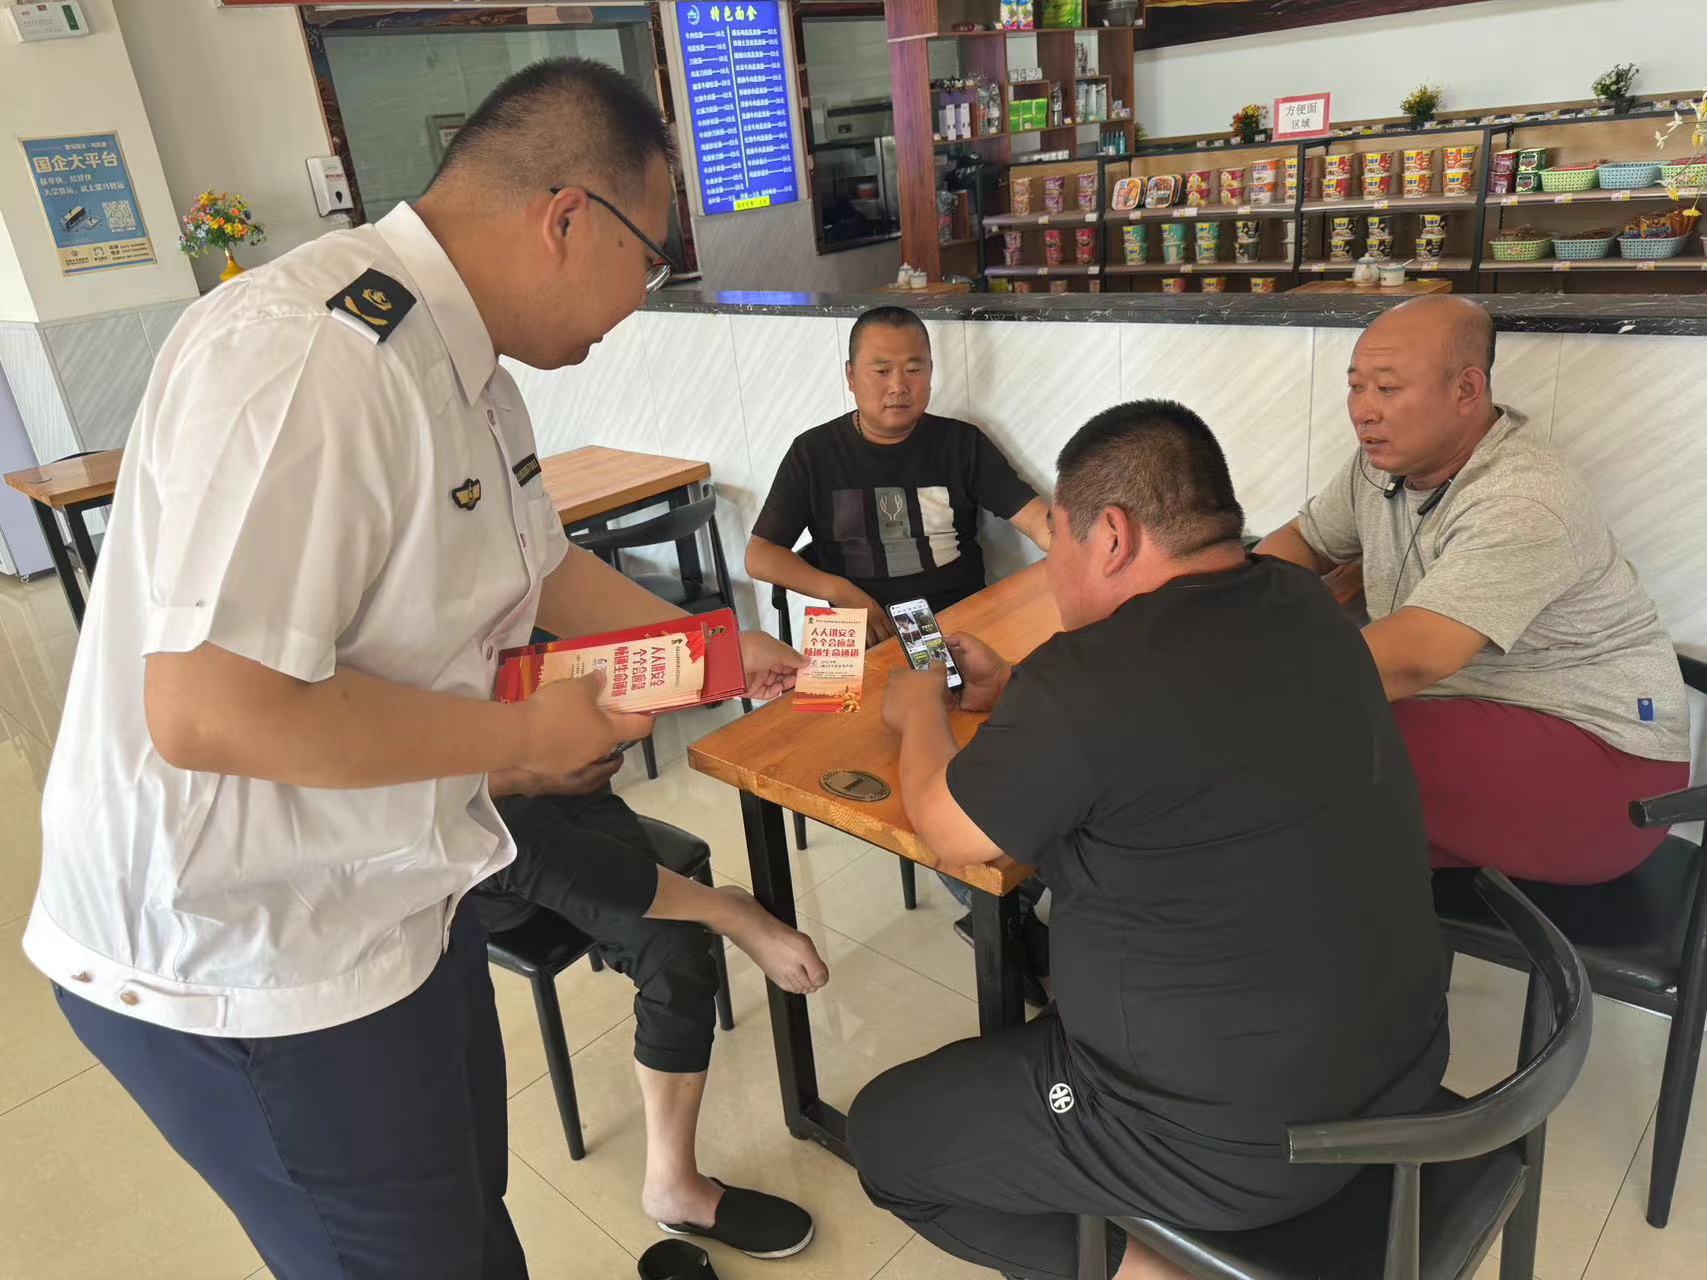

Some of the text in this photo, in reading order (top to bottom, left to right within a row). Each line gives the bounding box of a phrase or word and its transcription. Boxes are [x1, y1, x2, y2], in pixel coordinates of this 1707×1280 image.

[1285, 102, 1318, 116] 方便面
[1291, 118, 1311, 129] 区域
[32, 152, 118, 173] 国企大平台
[811, 628, 856, 637] 人人讲安全
[811, 638, 856, 647] 个个会应急
[804, 648, 859, 657] 畅通生命通道
[611, 645, 630, 697] 畅通生命通道
[631, 648, 647, 691] 个个会应急
[649, 646, 666, 687] 人人讲安全
